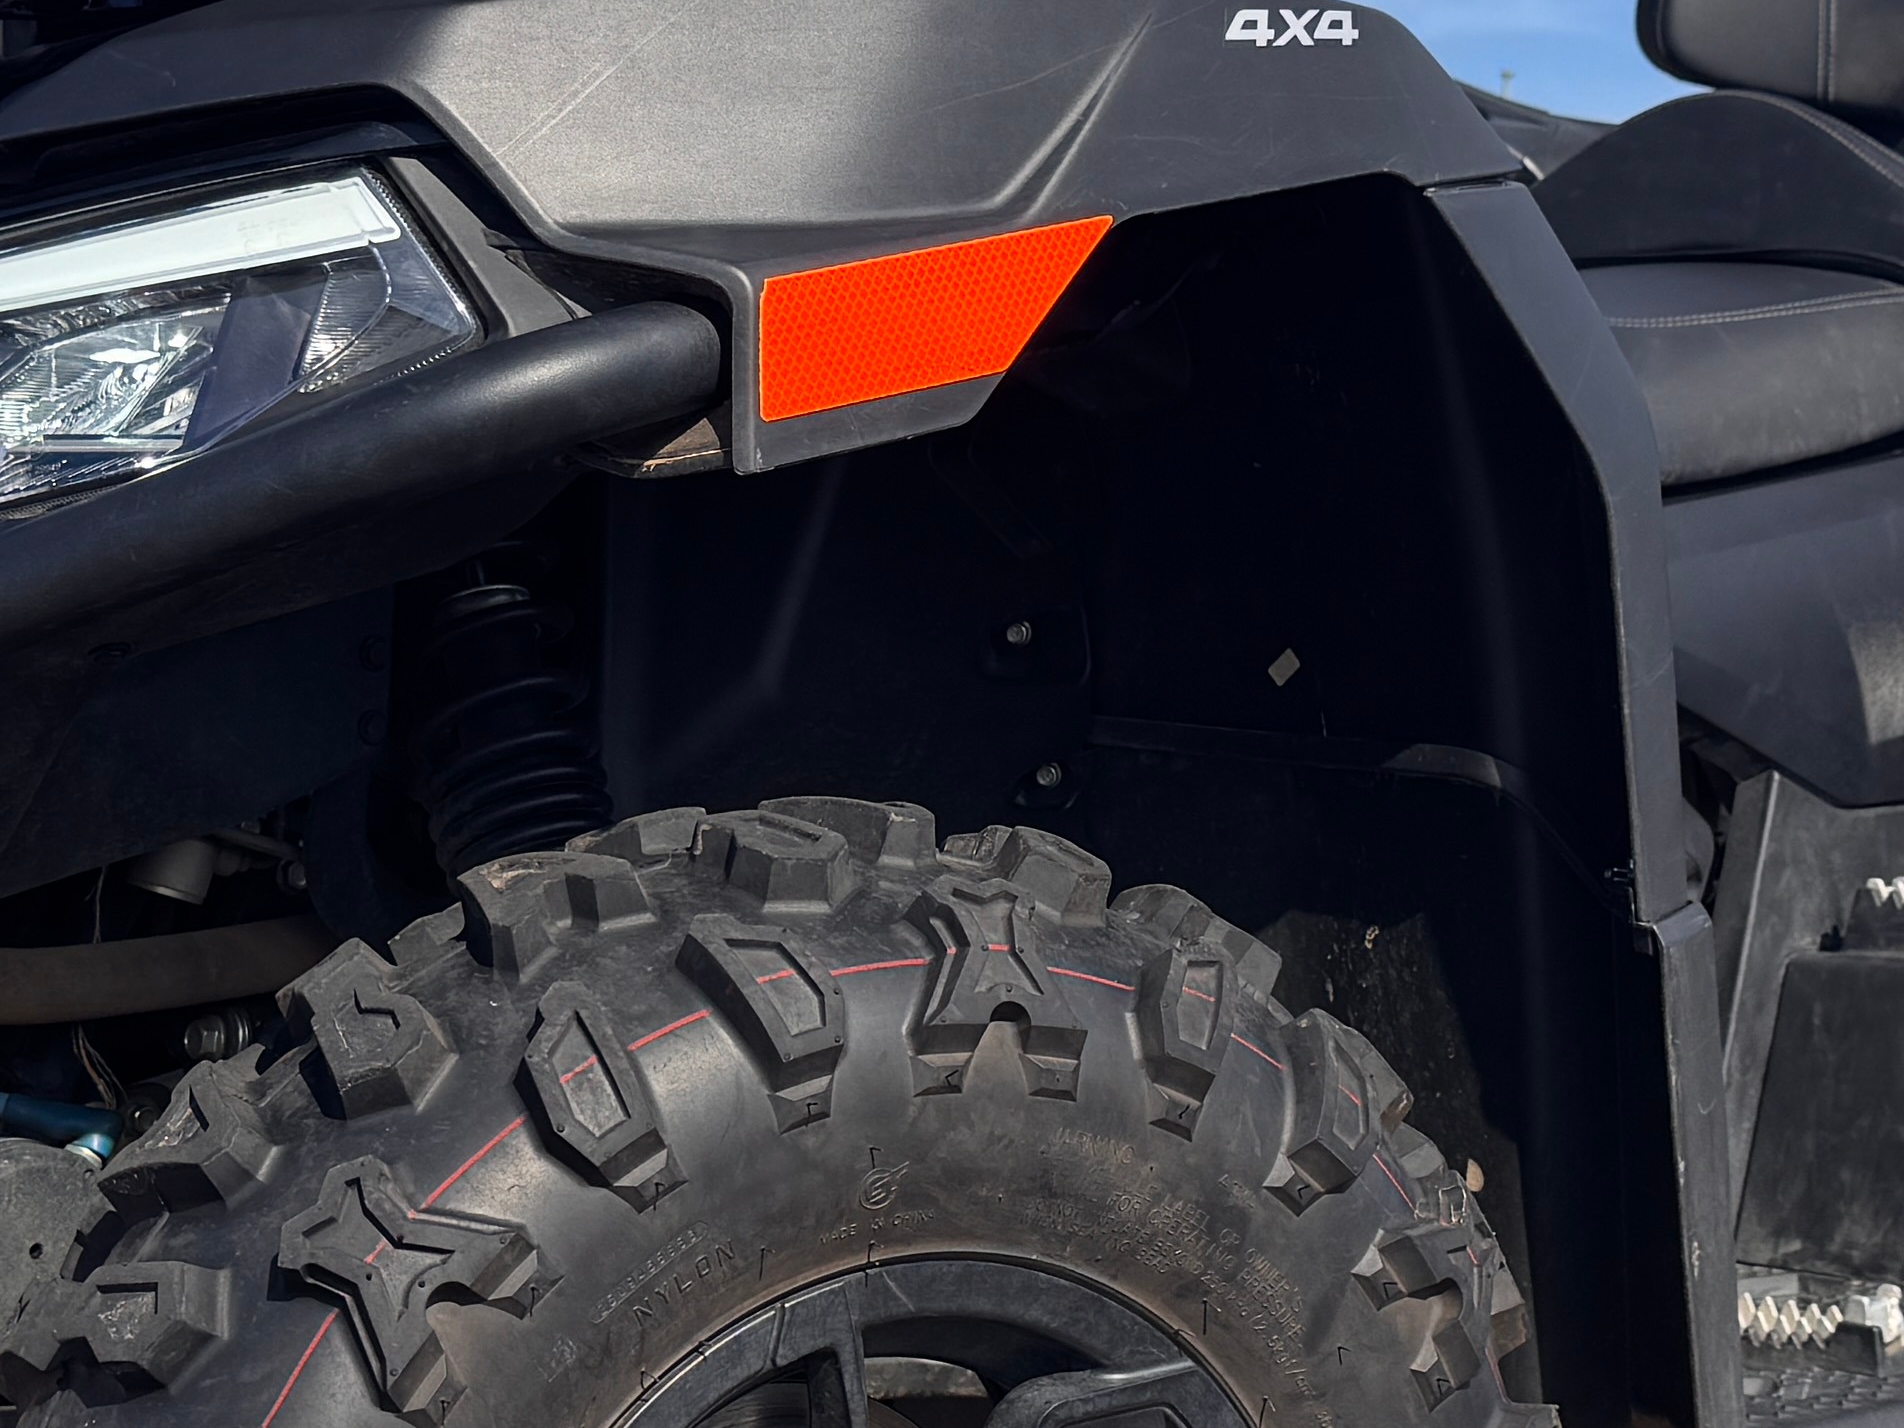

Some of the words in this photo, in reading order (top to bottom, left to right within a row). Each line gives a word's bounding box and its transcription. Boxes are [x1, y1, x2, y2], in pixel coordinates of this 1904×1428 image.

[1225, 8, 1360, 48] 4X4
[1105, 1188, 1144, 1220] FOR
[1145, 1205, 1237, 1274] OPERATING
[1161, 1192, 1213, 1231] LABEL
[817, 1221, 857, 1246] MADE
[629, 1235, 737, 1329] NYLON
